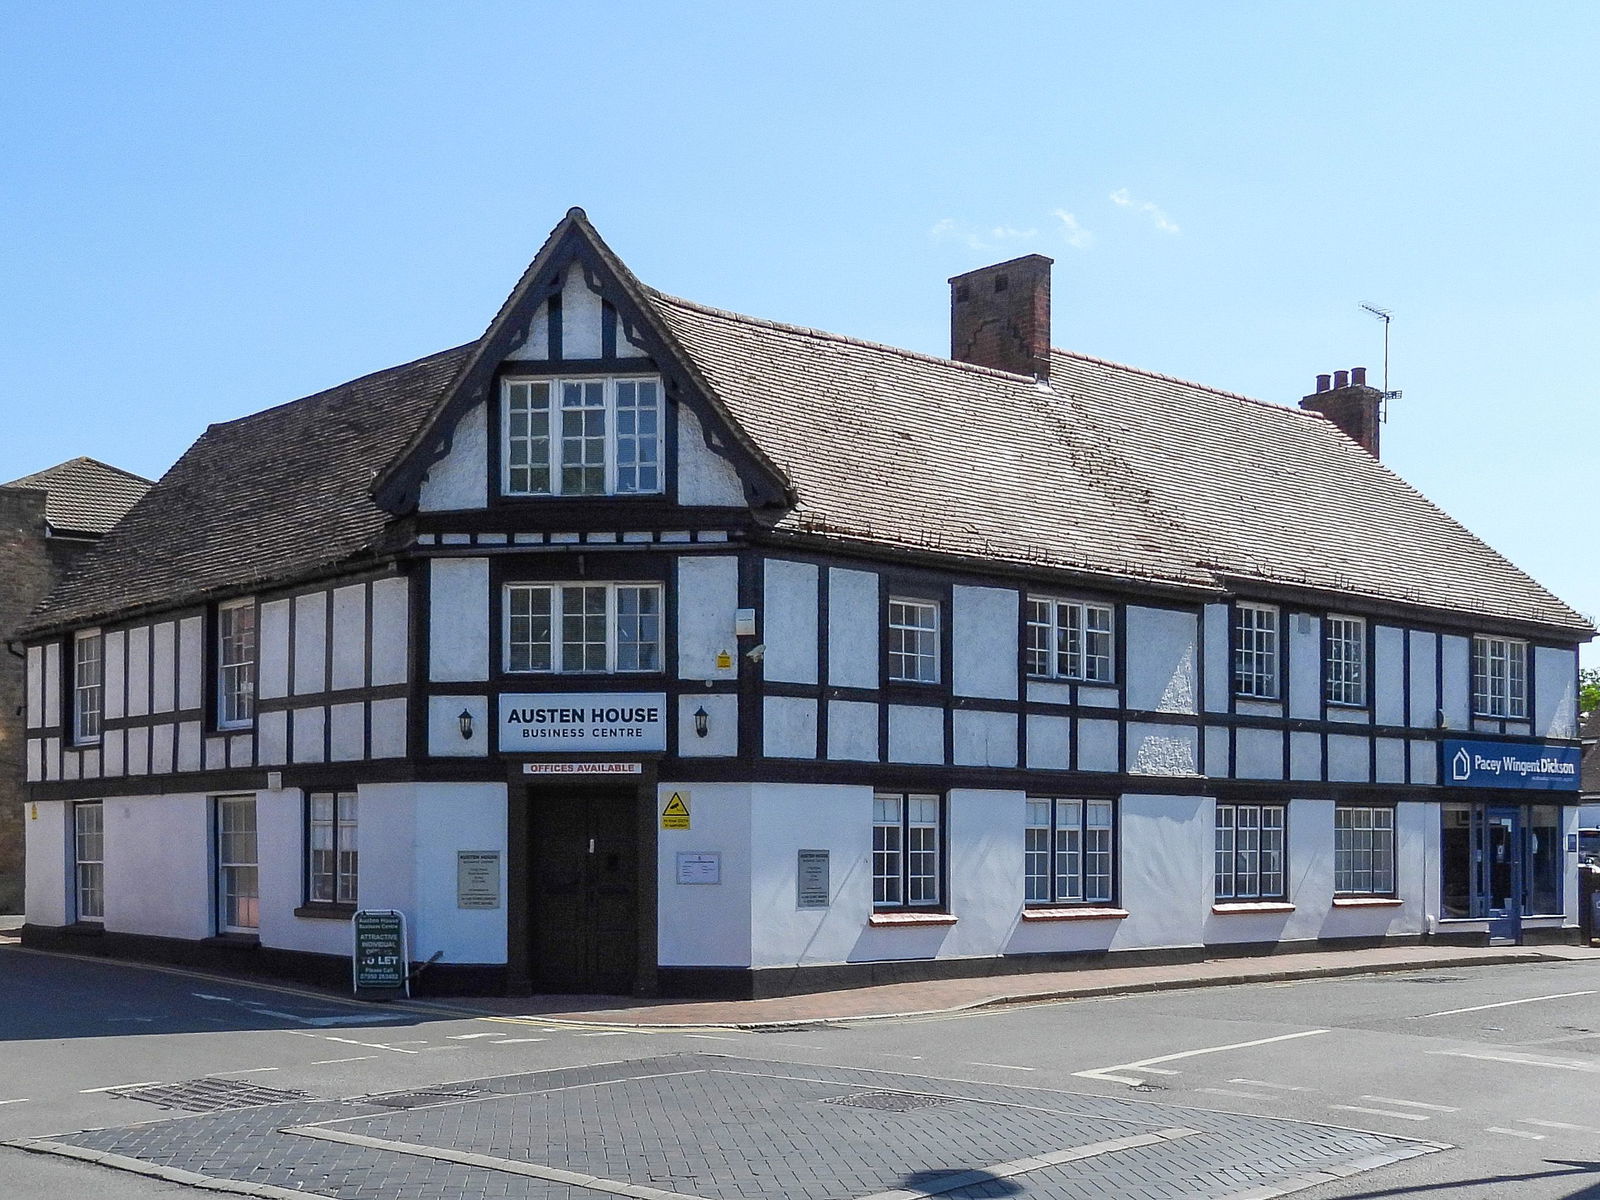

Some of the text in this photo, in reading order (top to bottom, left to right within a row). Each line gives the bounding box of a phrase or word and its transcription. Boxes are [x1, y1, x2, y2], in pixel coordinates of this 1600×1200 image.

[507, 708, 658, 723] AUSTEN HOUSE
[522, 728, 643, 738] BUSINESS CENTRE
[530, 764, 634, 773] OFFICES AVAILABLE
[1474, 755, 1575, 776] Pacey Wingent Dickson
[378, 956, 399, 965] LET
